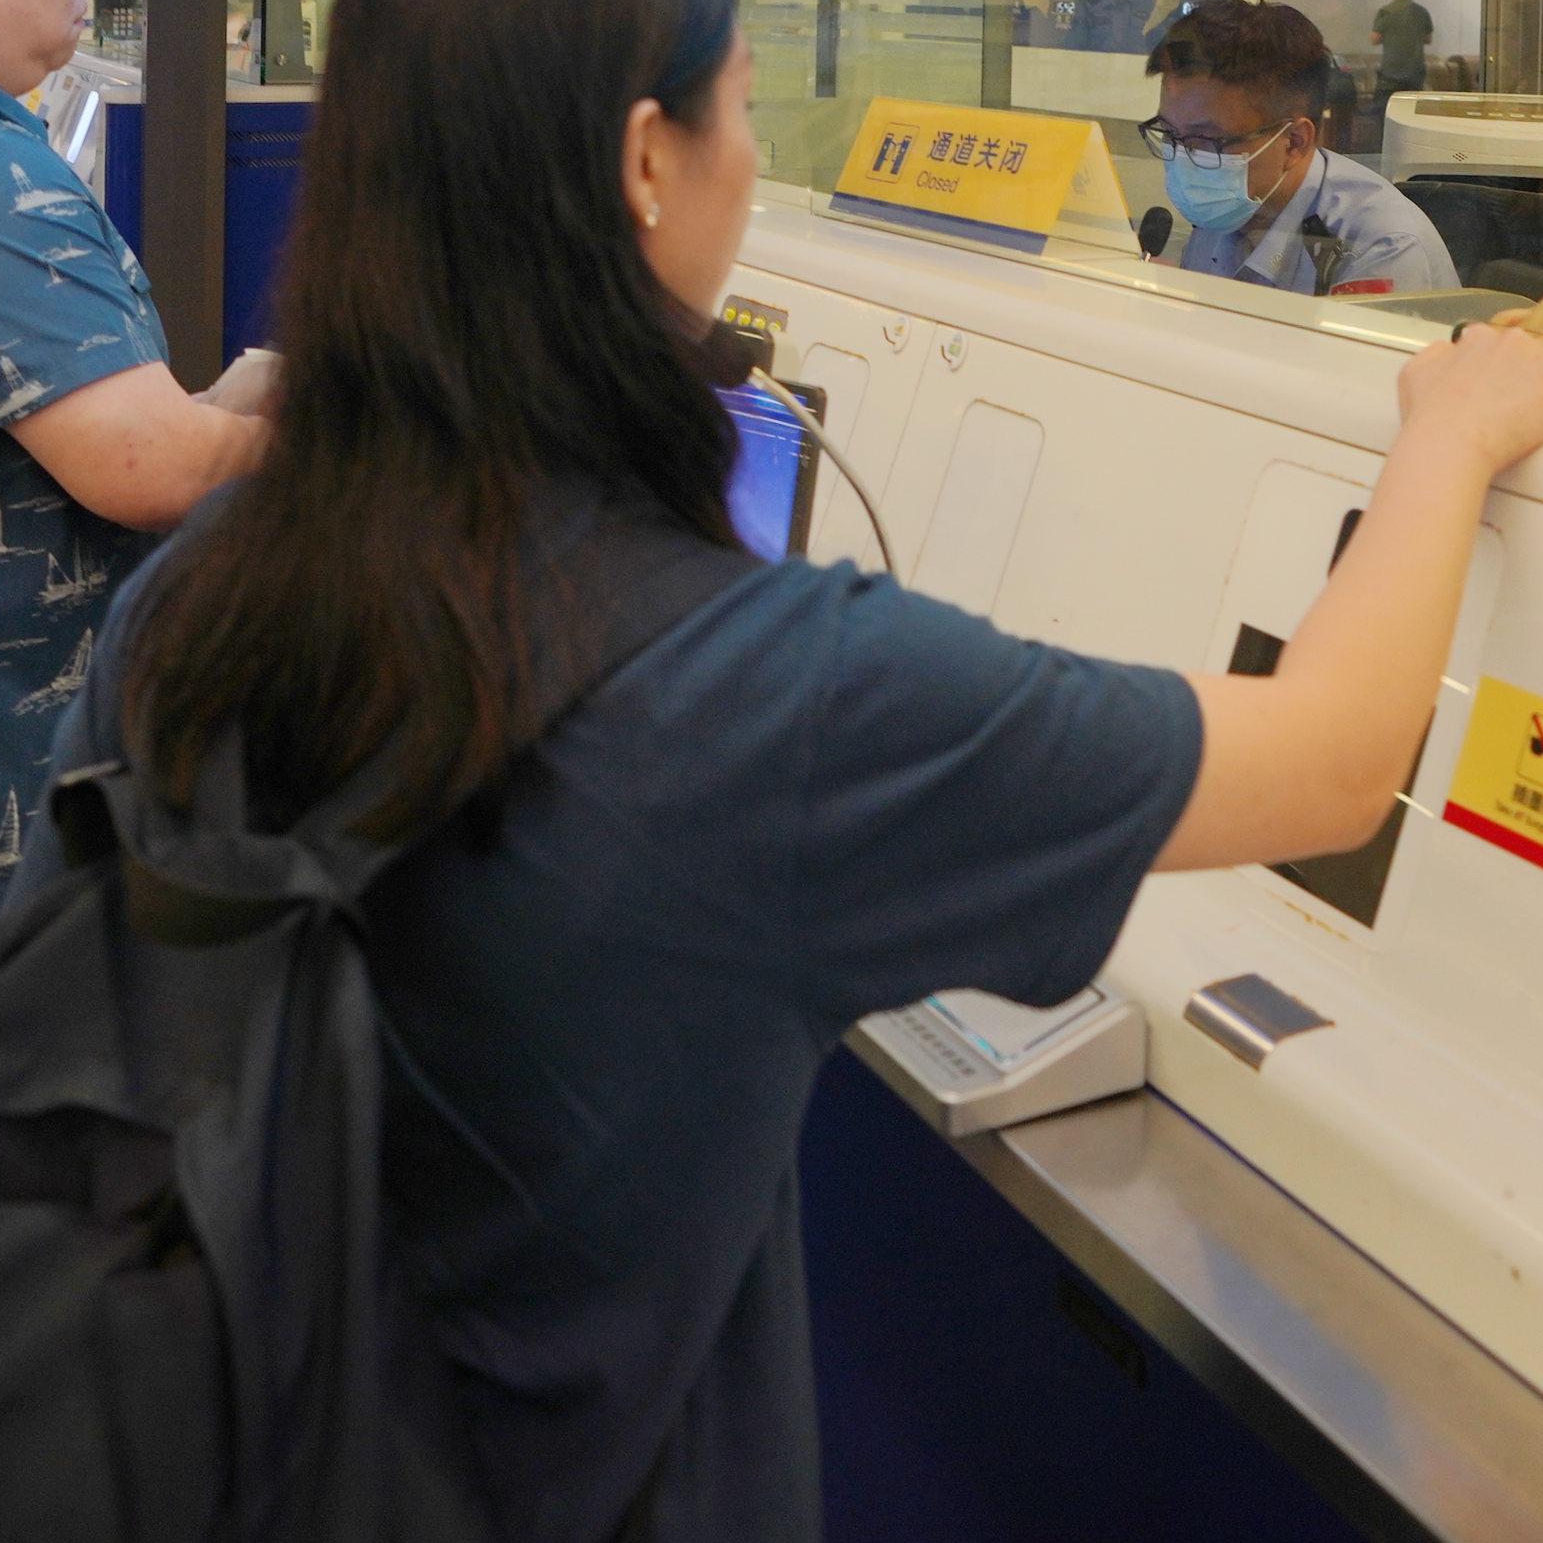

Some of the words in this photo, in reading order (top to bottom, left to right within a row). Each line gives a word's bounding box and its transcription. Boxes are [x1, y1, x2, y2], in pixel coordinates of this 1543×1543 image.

[926, 131, 1029, 175] 通道关闭
[916, 170, 960, 194] Closed
